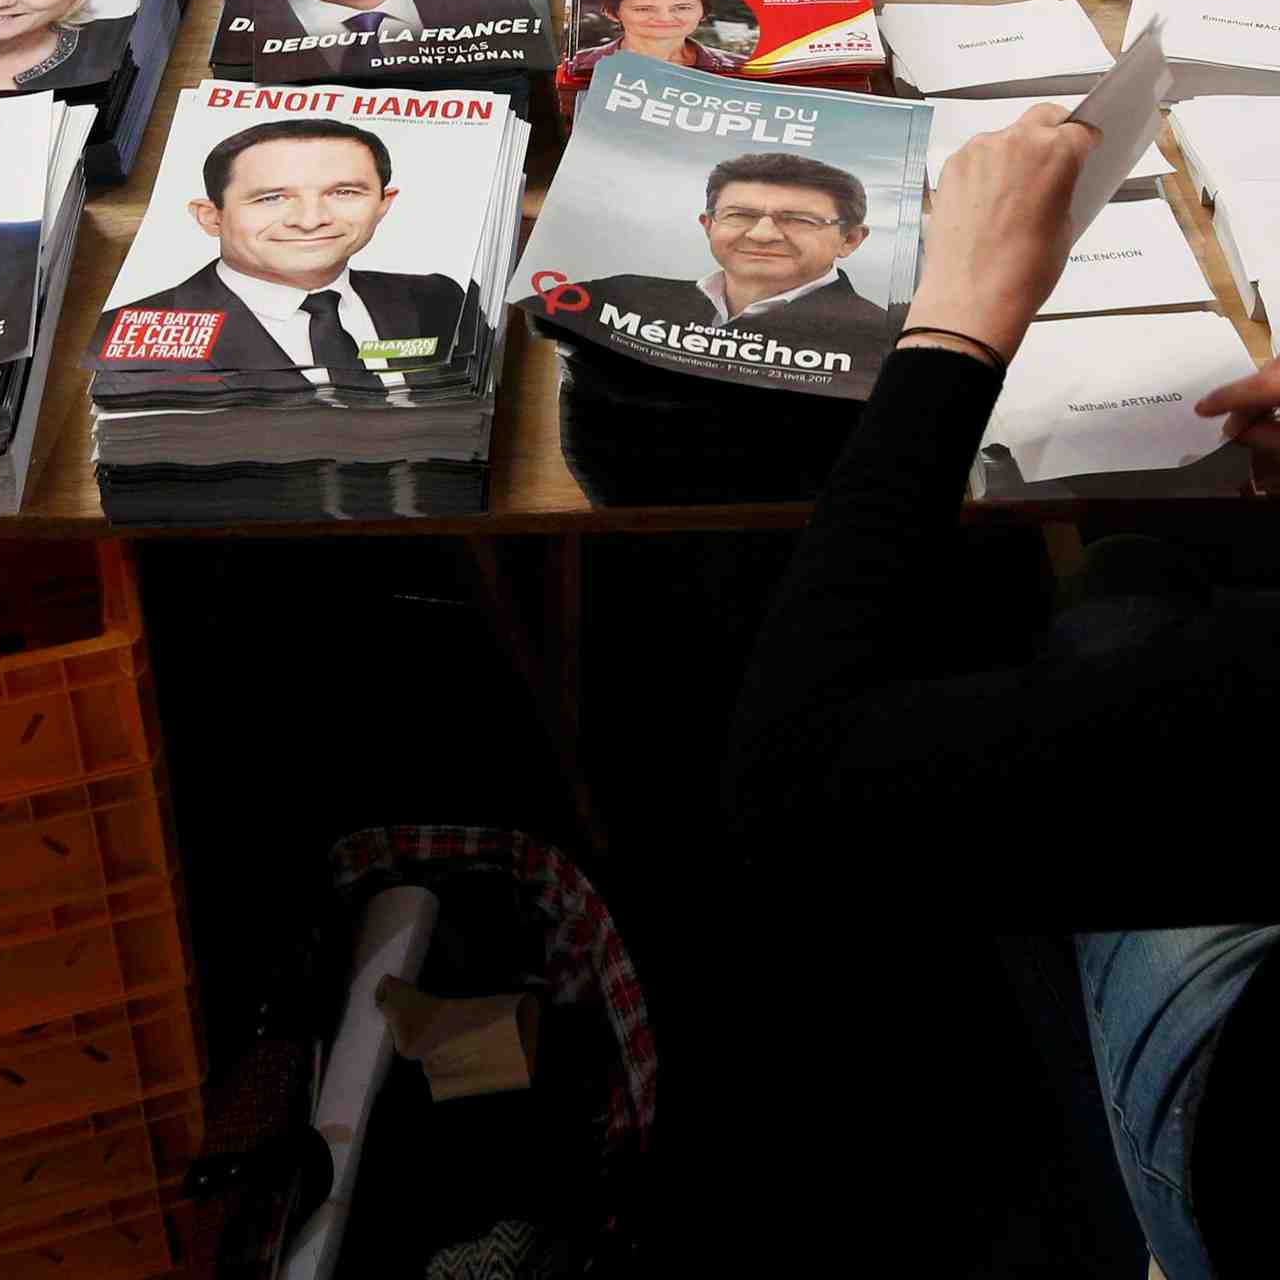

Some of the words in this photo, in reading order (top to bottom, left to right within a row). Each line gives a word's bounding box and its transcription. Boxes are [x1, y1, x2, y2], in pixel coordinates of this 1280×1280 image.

[261, 31, 375, 54] DEBOUT
[378, 30, 415, 44] LA
[418, 41, 489, 55] NICOLAS
[370, 49, 525, 68] DUPONT-AIGNAN
[206, 87, 345, 112] BENOIT
[351, 95, 494, 120] HAMON
[613, 72, 650, 95] LA
[662, 86, 763, 116] FORCE
[773, 105, 819, 124] DU
[604, 88, 817, 147] PEUPLE
[120, 309, 165, 326] FAIRE
[163, 311, 221, 327] BATTRE
[111, 324, 143, 345] LE
[598, 303, 852, 373] Mélenchon
[683, 321, 764, 342] Jean-Luc
[105, 343, 127, 358] DE
[127, 344, 147, 358] LA
[149, 345, 208, 359] FRANCE
[1067, 401, 1119, 414] Nathalie
[1120, 391, 1184, 409] ARTHAUD
